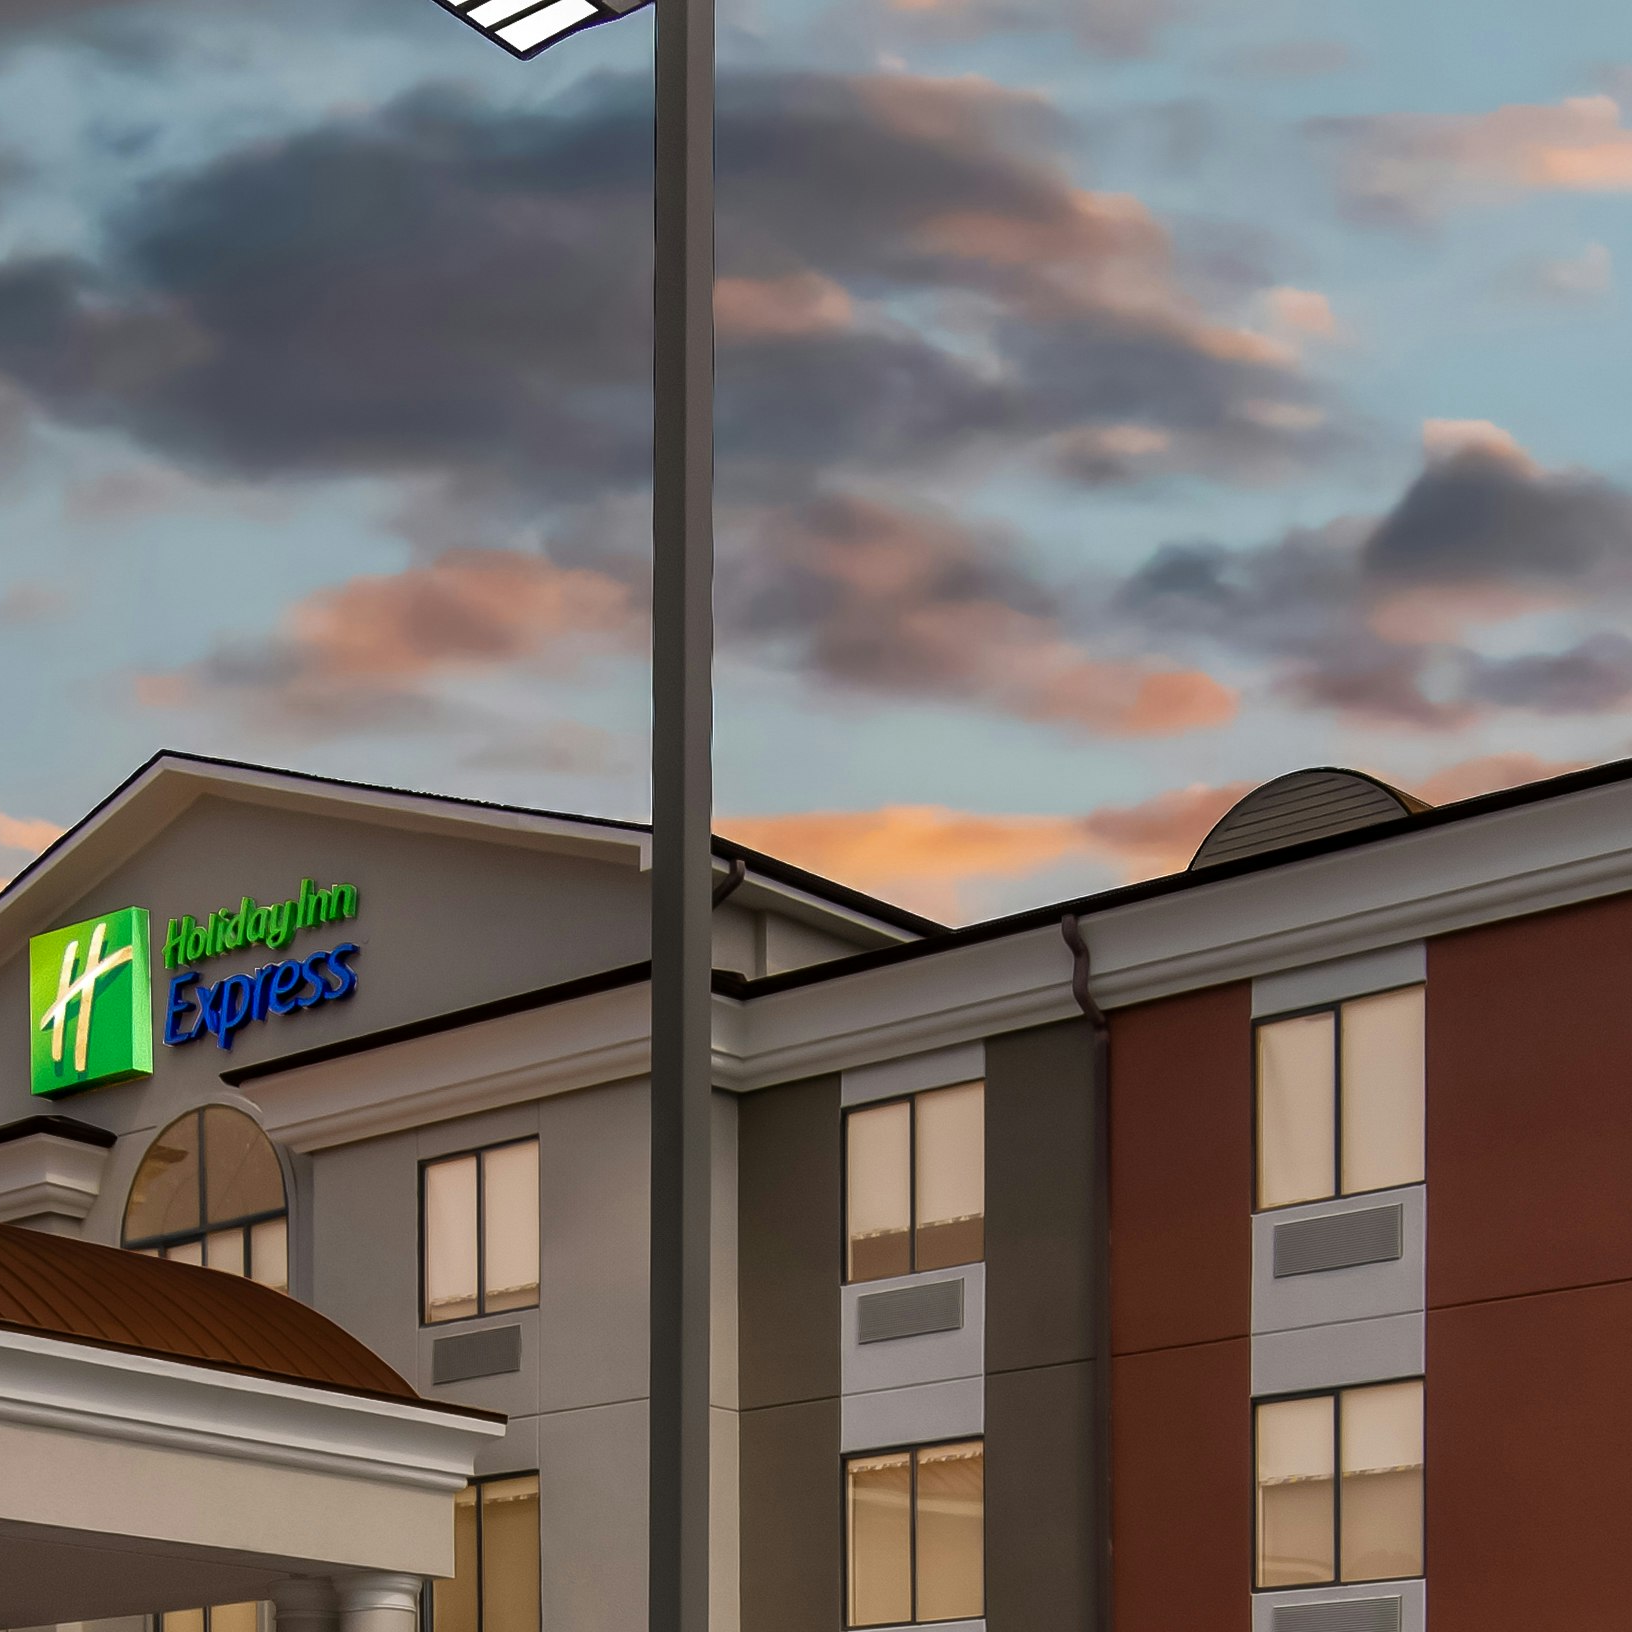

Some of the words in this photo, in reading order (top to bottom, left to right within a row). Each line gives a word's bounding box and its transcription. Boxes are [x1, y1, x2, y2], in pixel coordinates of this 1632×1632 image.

[162, 896, 297, 969] Holiday
[297, 878, 358, 929] Inn
[163, 943, 360, 1051] Express
